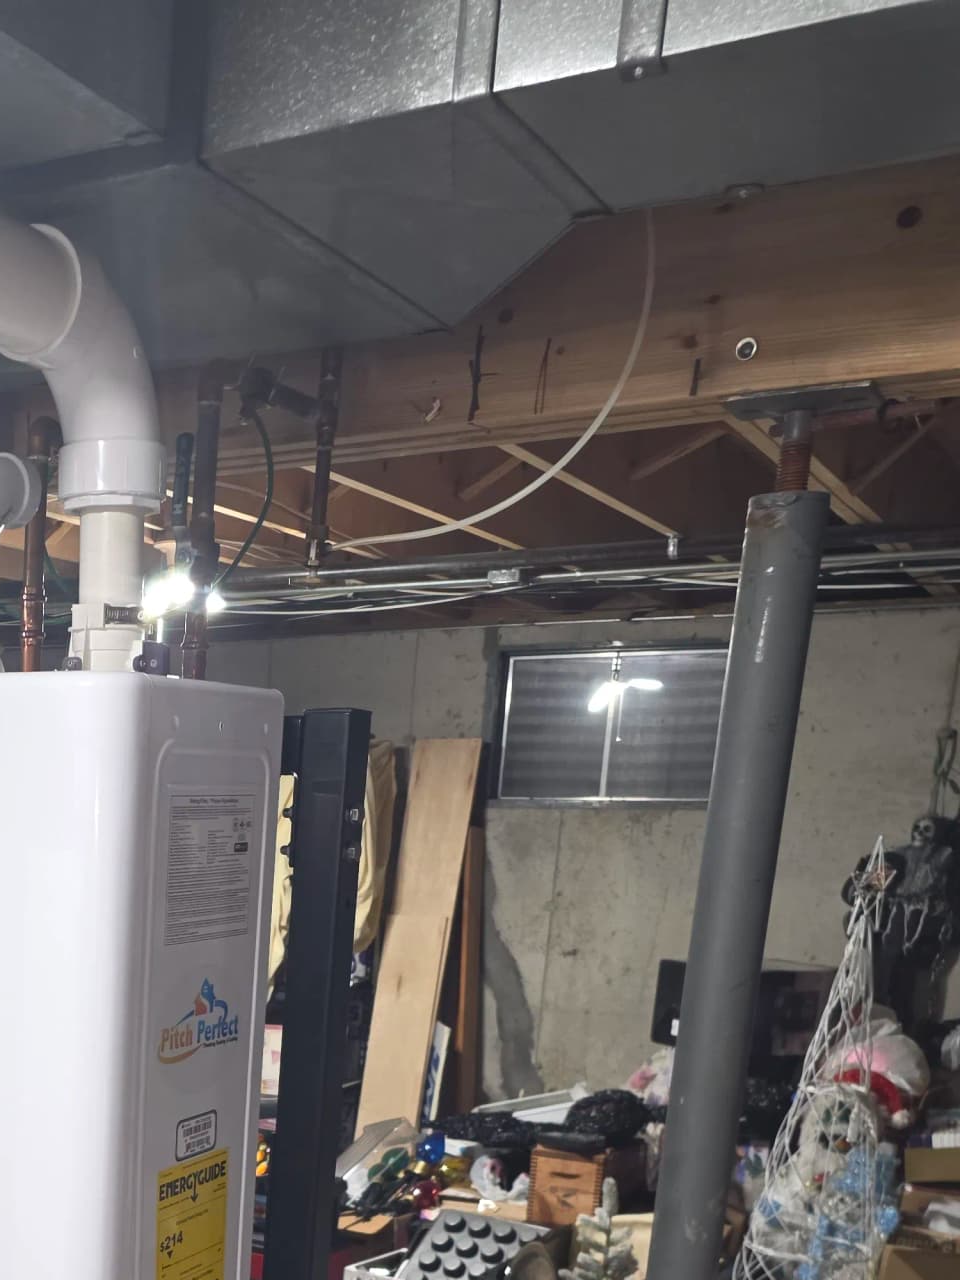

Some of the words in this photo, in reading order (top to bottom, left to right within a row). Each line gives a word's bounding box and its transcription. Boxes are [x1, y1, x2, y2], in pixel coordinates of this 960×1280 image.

[161, 1024, 193, 1052] Pitch
[197, 1016, 238, 1043] Perfect
[159, 1160, 227, 1201] ENERGYGUIDE
[160, 1230, 184, 1252] $214
